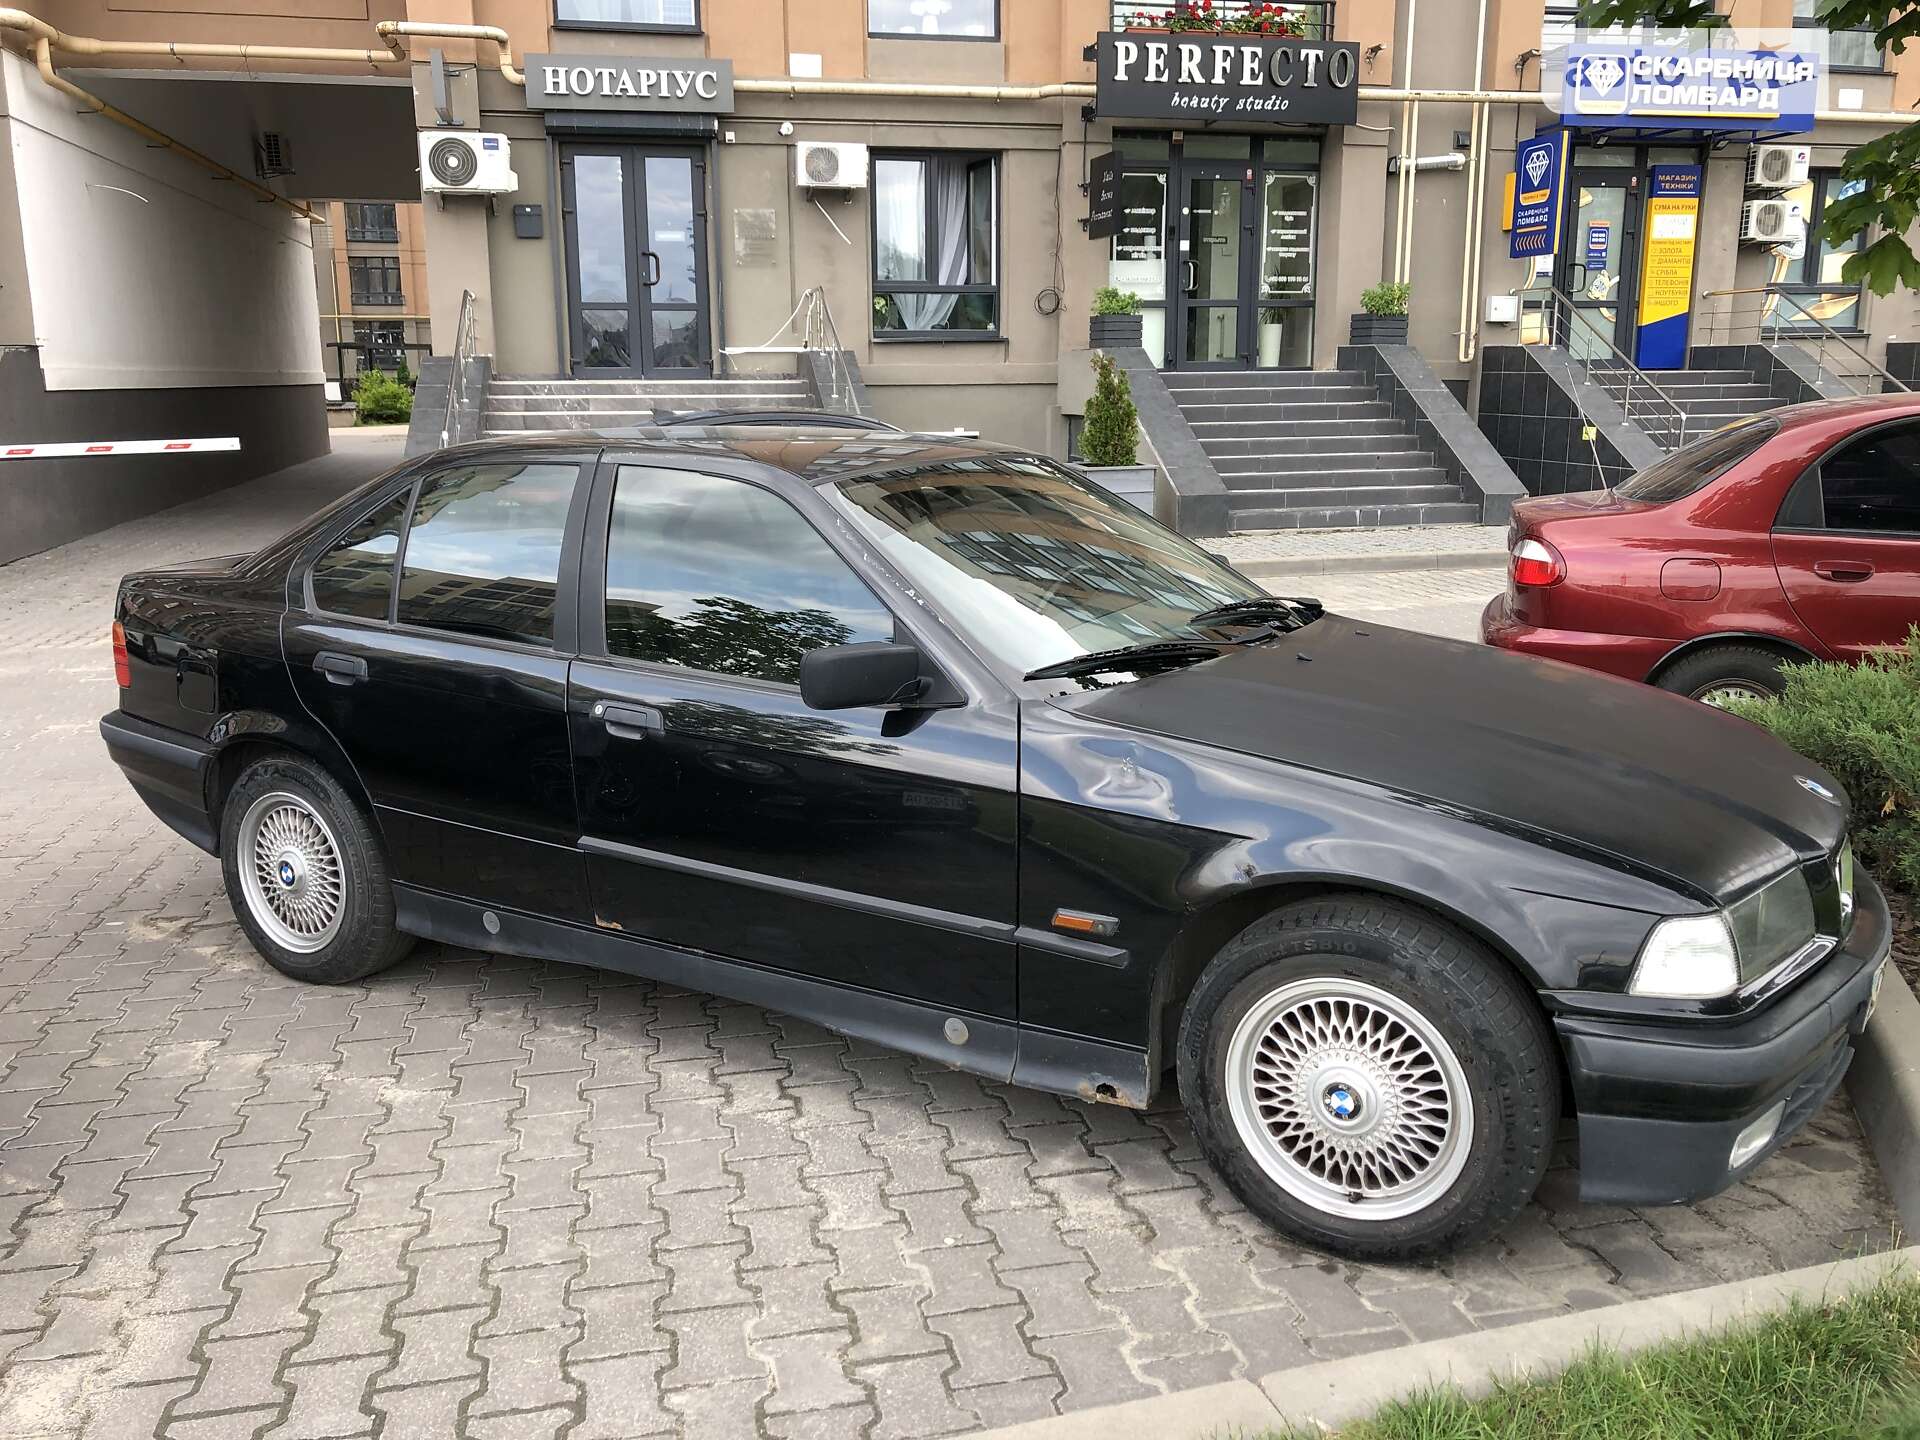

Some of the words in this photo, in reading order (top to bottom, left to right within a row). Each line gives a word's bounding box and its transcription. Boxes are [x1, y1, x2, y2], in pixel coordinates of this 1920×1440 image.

[1113, 41, 1355, 88] PERFECTO
[1632, 55, 1815, 84] СКАРБНИЦЯ
[542, 66, 717, 99] НОТАРІУС
[1171, 91, 1230, 113] beauty
[1236, 93, 1290, 112] studio
[1630, 84, 1780, 110] ЛОМБАРД
[1658, 174, 1698, 182] МАГАЗИН
[1660, 182, 1695, 190] ТЕХНІКИ
[1516, 214, 1548, 226] ЛОМБАРД
